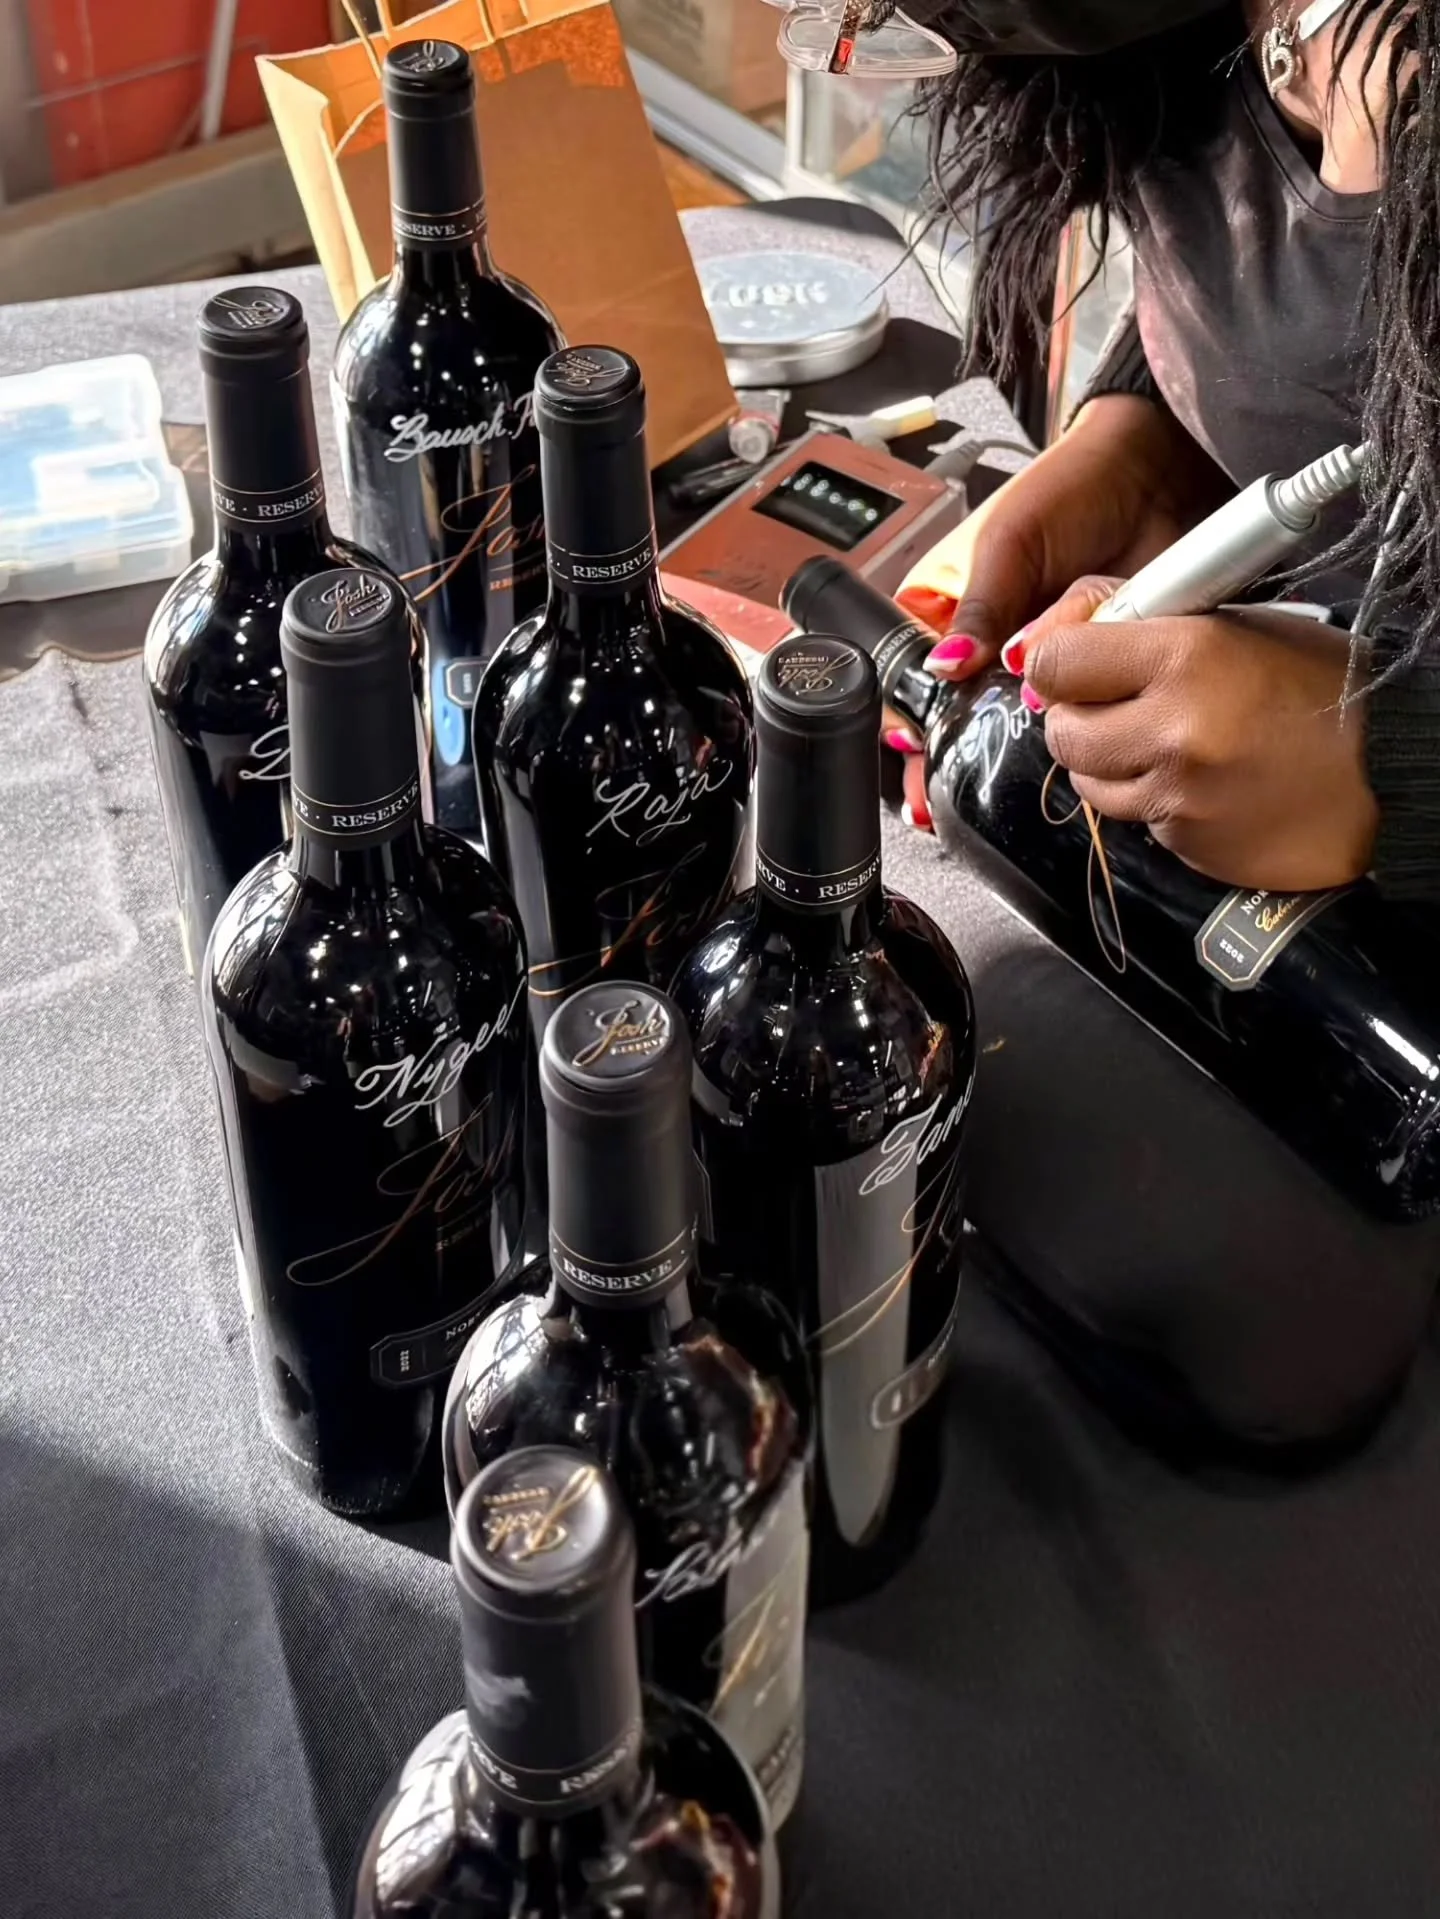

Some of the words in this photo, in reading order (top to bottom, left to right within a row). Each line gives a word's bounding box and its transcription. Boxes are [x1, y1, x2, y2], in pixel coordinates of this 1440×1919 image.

[572, 548, 652, 578] RESERVE
[332, 781, 418, 827] RESERVE
[563, 1256, 672, 1289] RESERVE
